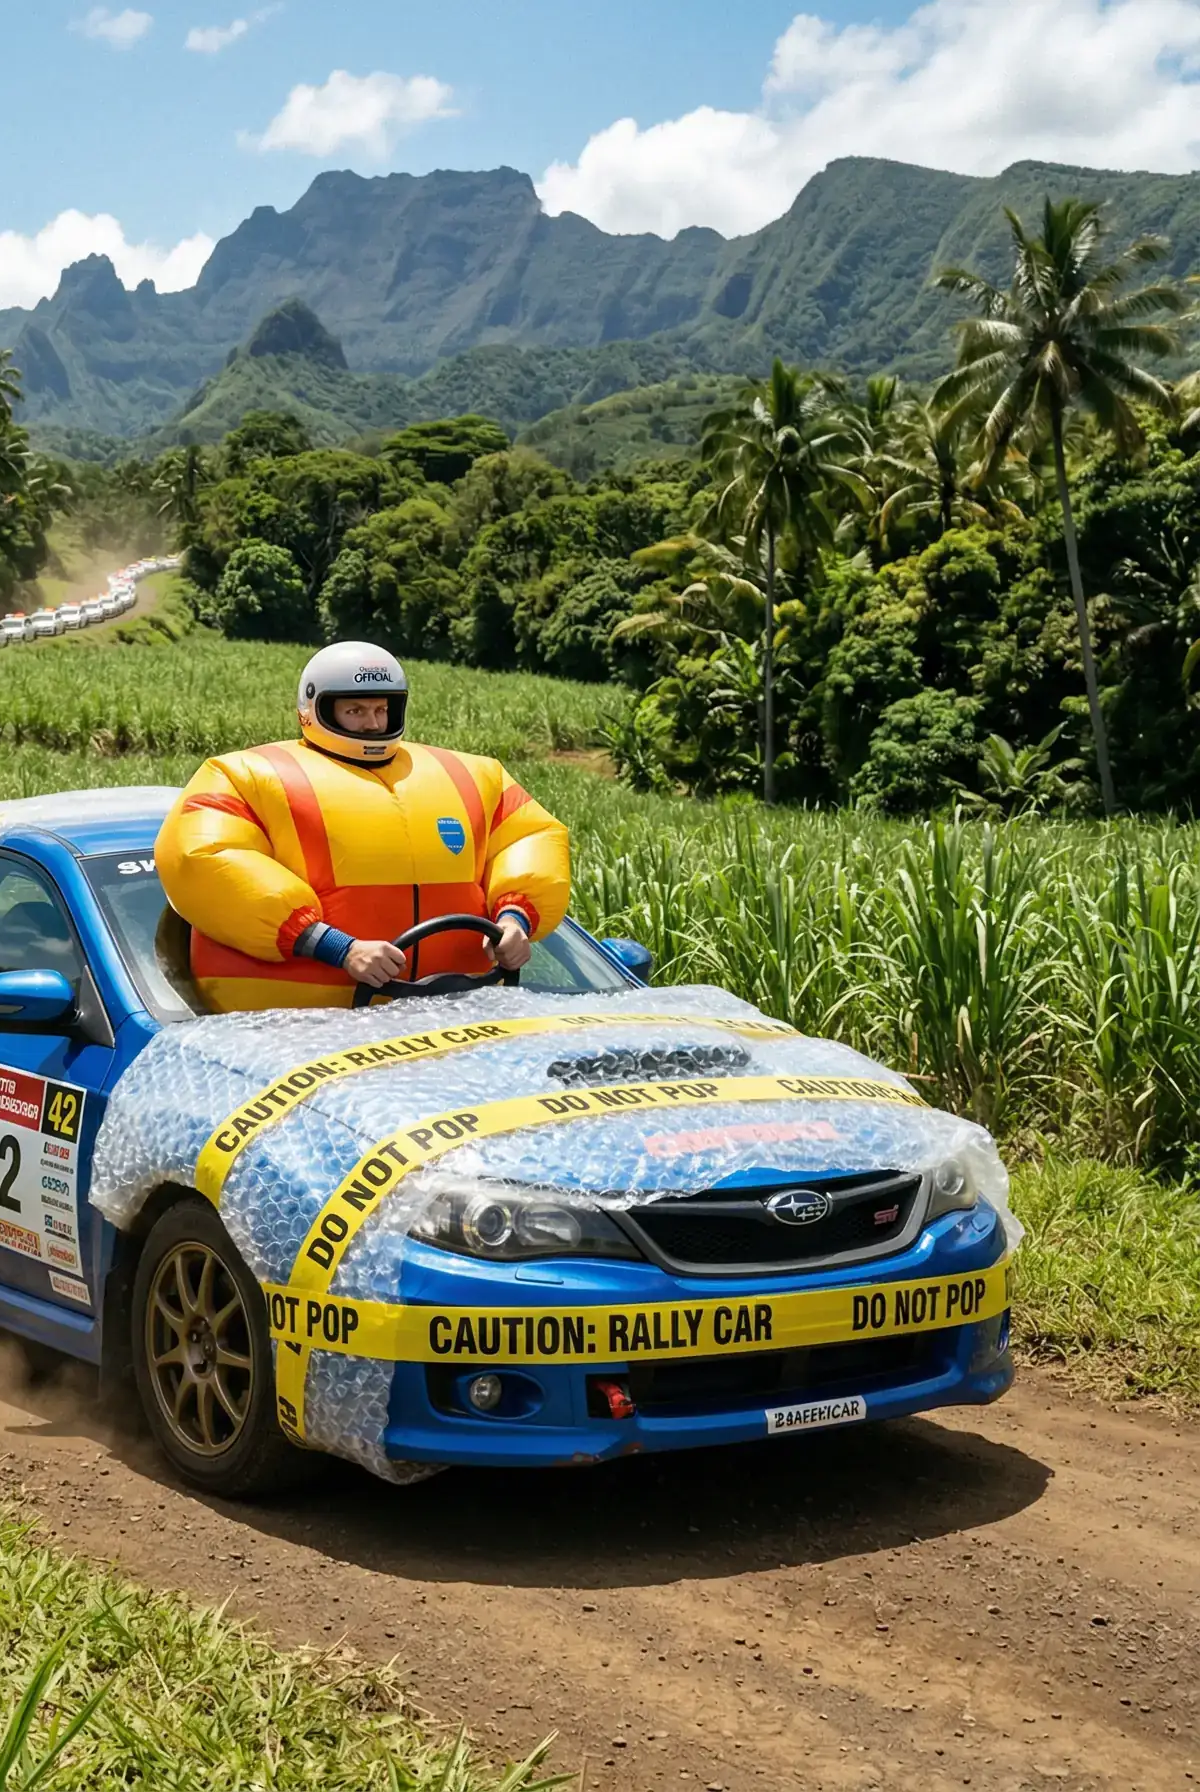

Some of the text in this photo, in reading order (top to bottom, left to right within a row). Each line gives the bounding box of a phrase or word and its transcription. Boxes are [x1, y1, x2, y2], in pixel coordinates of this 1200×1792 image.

[47, 1091, 78, 1137] 42
[214, 1023, 511, 1153] CAUTION: RALLY CAR
[536, 1082, 720, 1115] DO NOT POP
[306, 1112, 480, 1271] DO NOT POP
[306, 1300, 359, 1344] POP
[429, 1315, 596, 1355] CAUTION:
[608, 1308, 704, 1353] RALLY
[713, 1303, 773, 1345] CAR
[852, 1292, 887, 1331] DO
[894, 1285, 942, 1326] NOT
[945, 1278, 986, 1318] POP
